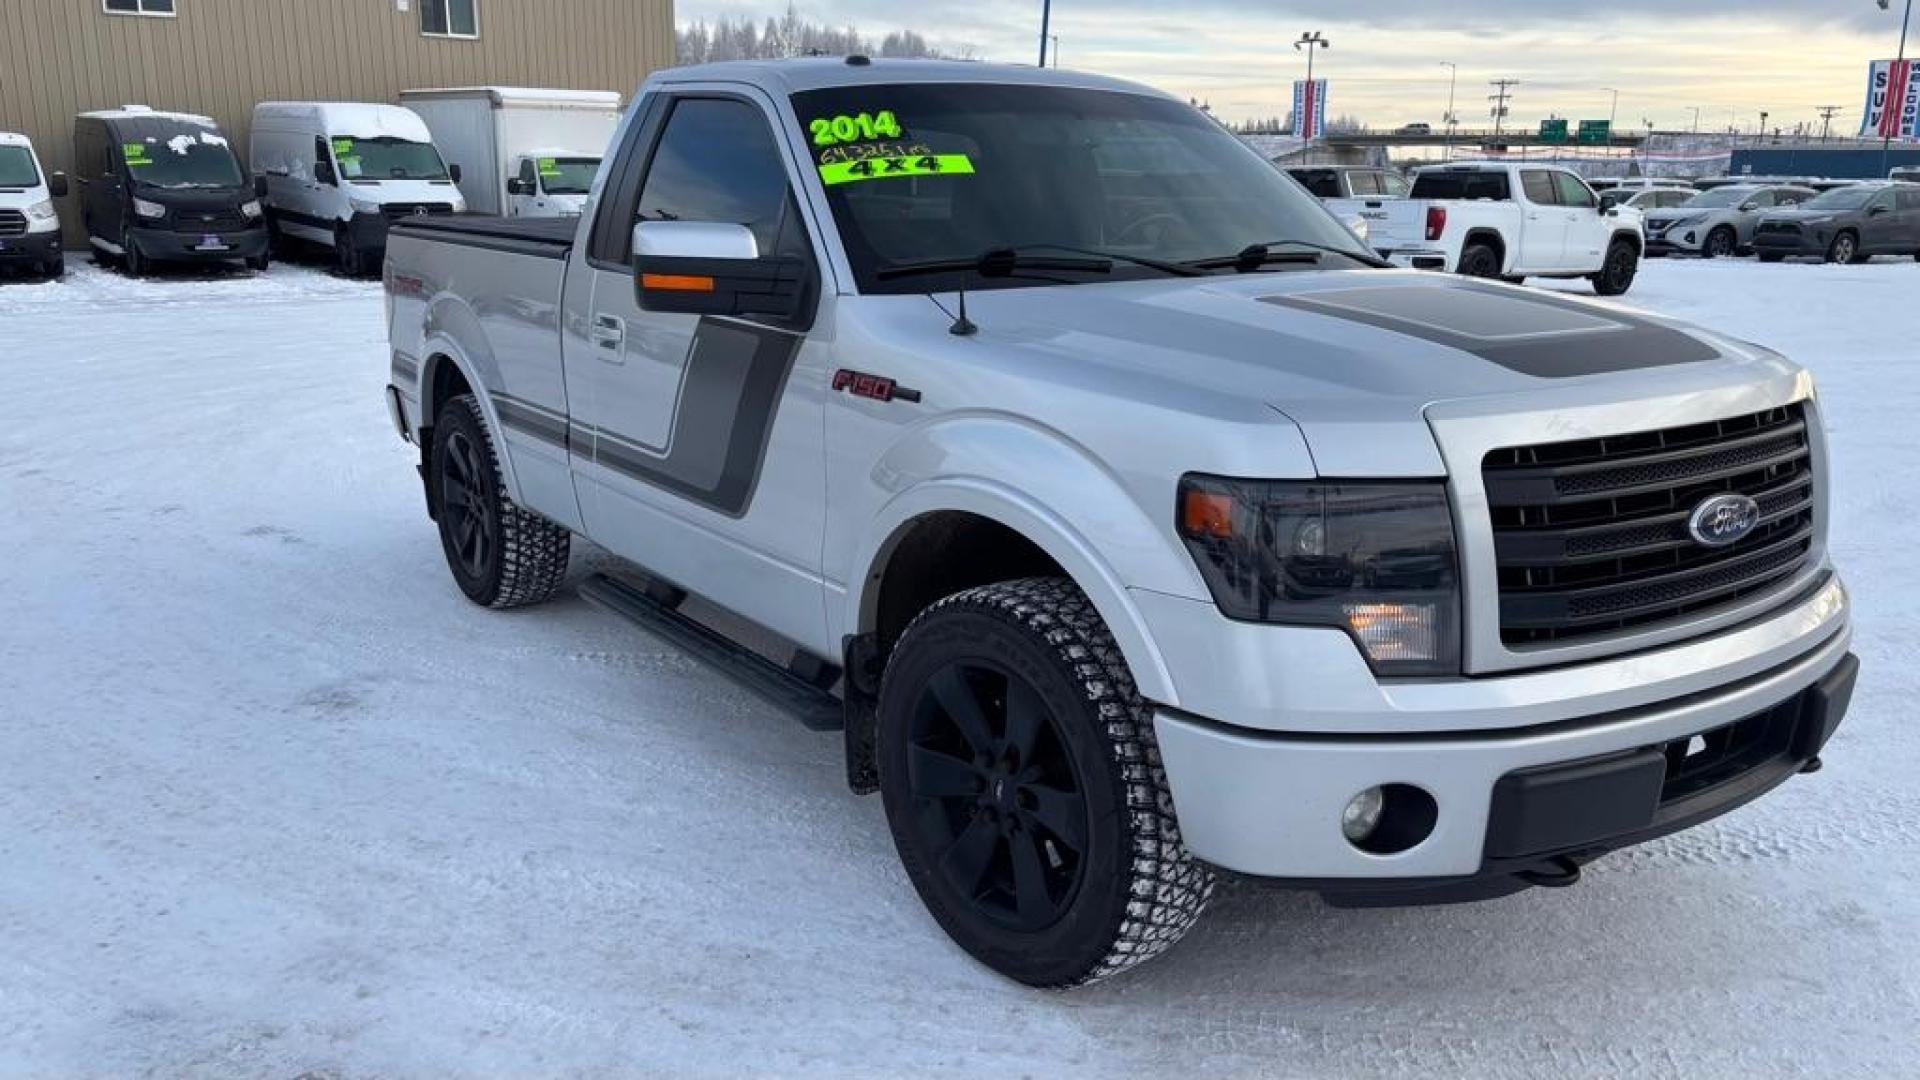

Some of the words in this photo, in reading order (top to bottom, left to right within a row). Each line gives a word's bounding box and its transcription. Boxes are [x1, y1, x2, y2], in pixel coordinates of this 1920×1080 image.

[810, 111, 901, 145] 2014
[832, 368, 897, 401] F-150
[1706, 503, 1747, 535] Ford
